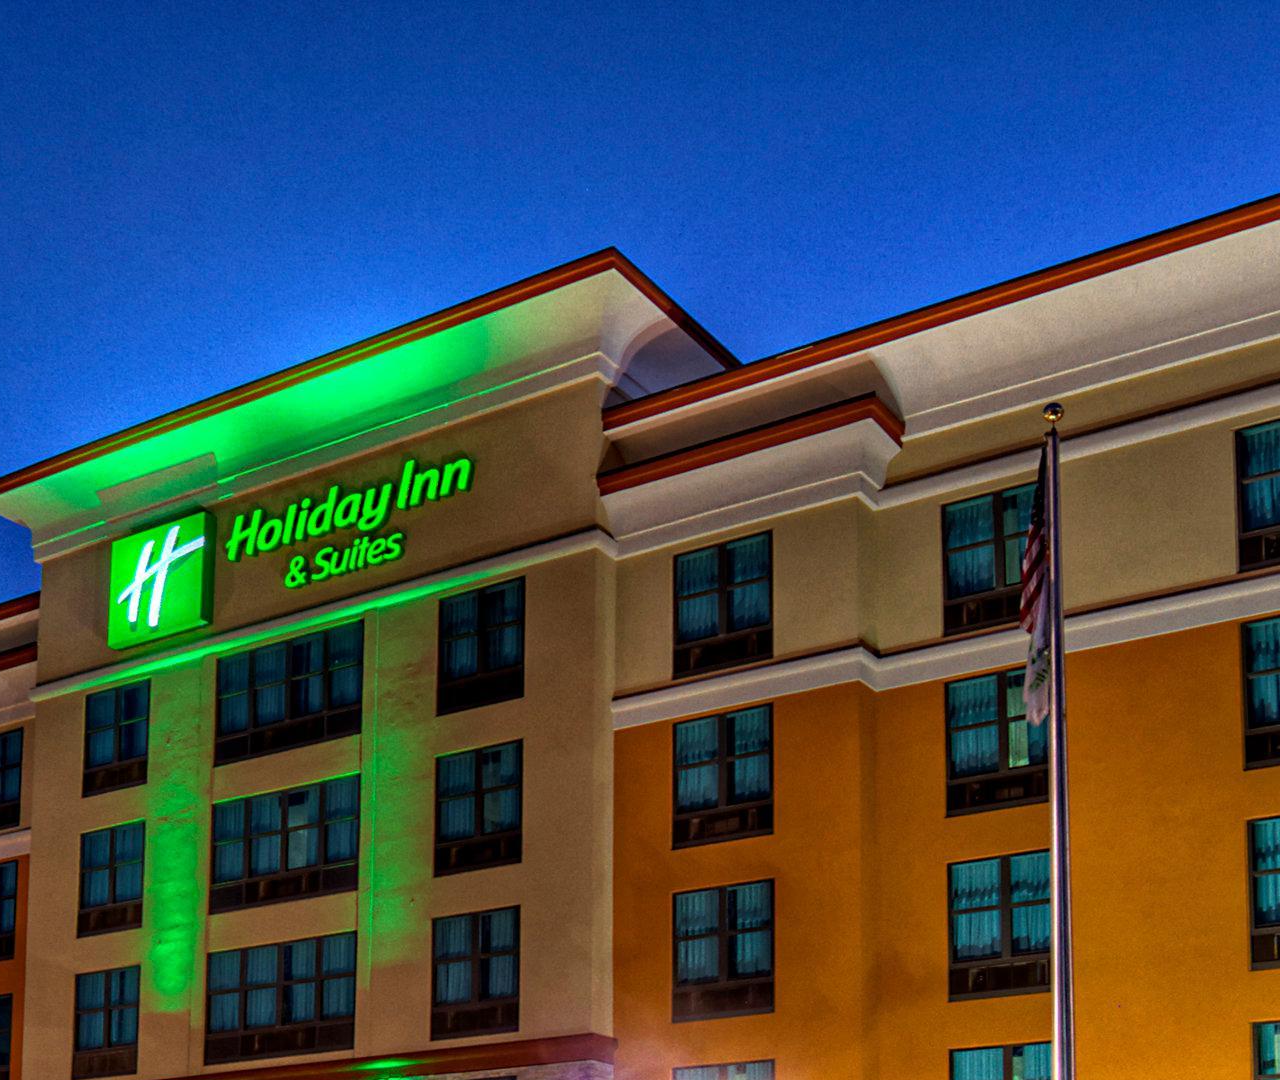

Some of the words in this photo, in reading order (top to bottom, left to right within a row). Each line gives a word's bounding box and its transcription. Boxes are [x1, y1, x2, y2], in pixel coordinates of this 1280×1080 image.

[226, 483, 392, 562] Holiday
[397, 457, 472, 510] Inn
[284, 556, 306, 589] &
[311, 532, 403, 581] Suites
